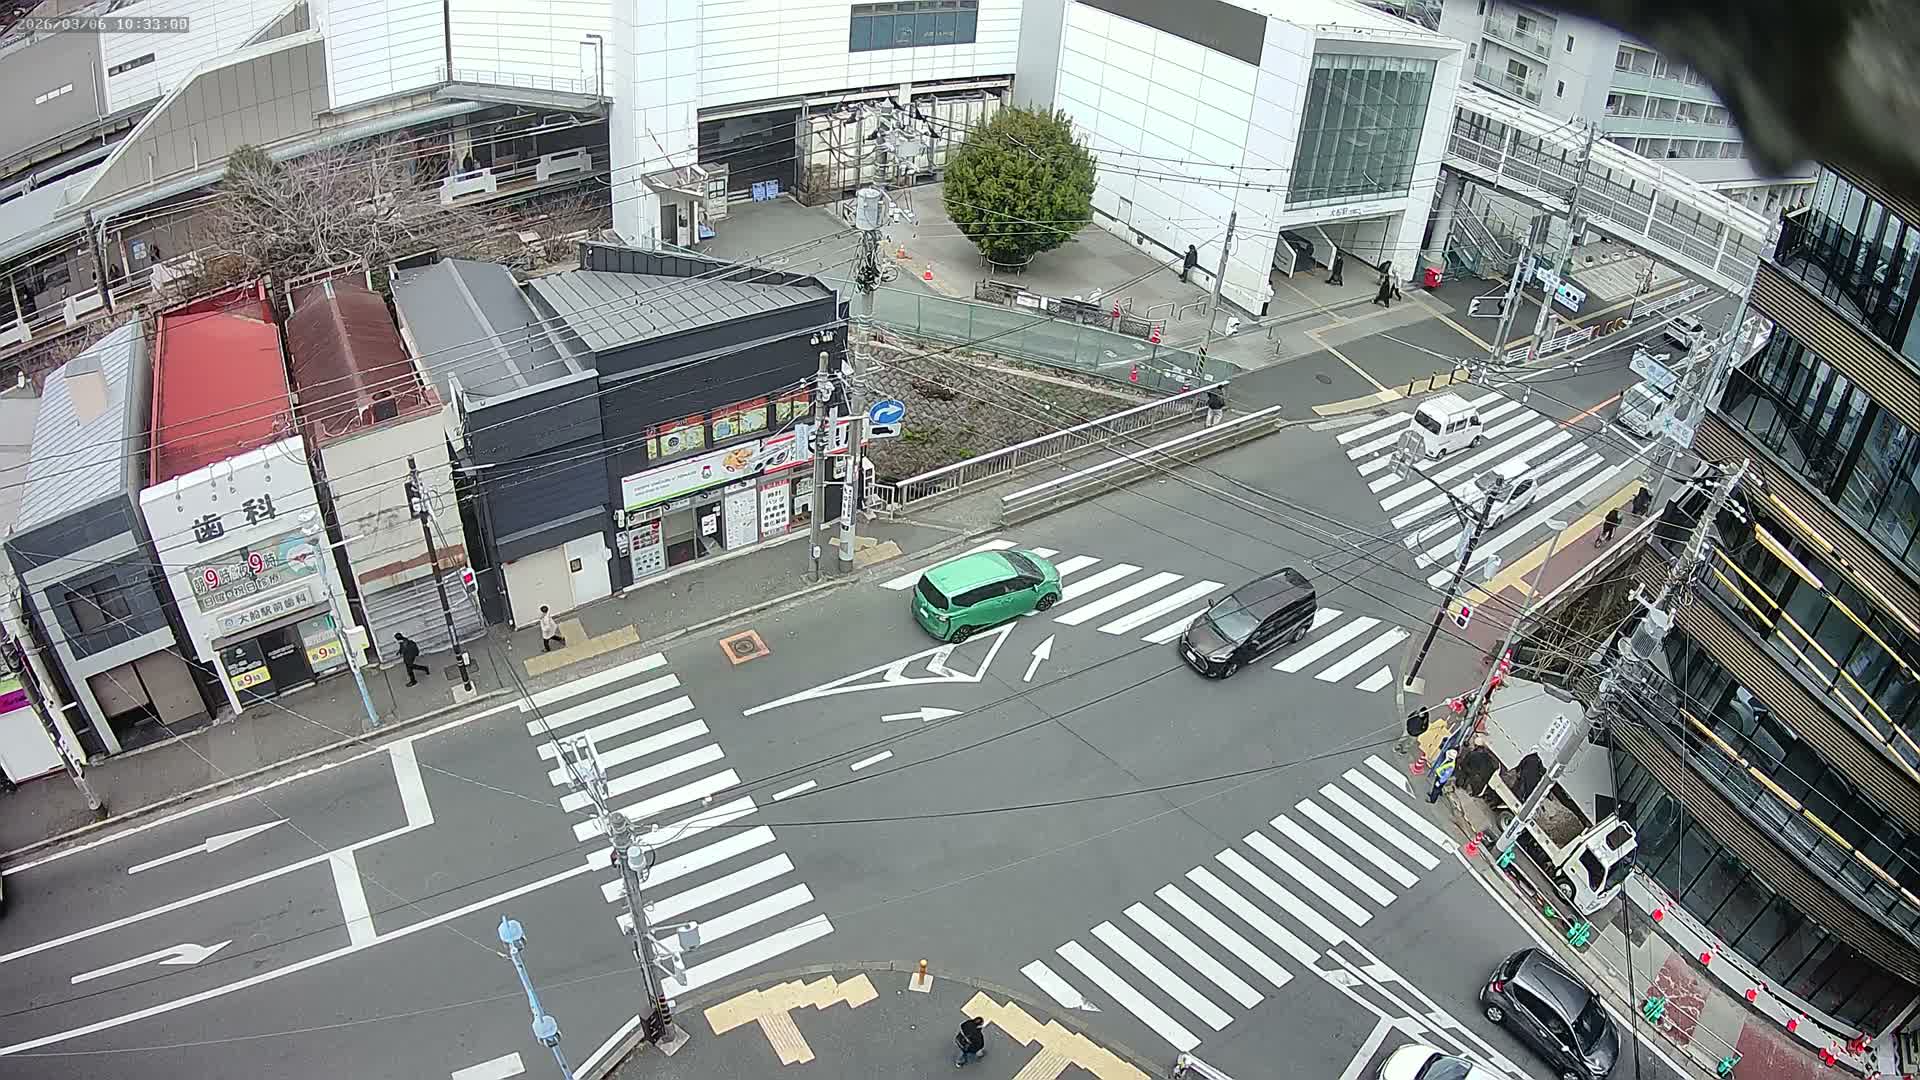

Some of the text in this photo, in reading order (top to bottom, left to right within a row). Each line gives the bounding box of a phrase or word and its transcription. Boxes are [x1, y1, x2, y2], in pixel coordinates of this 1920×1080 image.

[192, 494, 276, 543] 歯科
[239, 593, 307, 625] 大船駅前歯科
